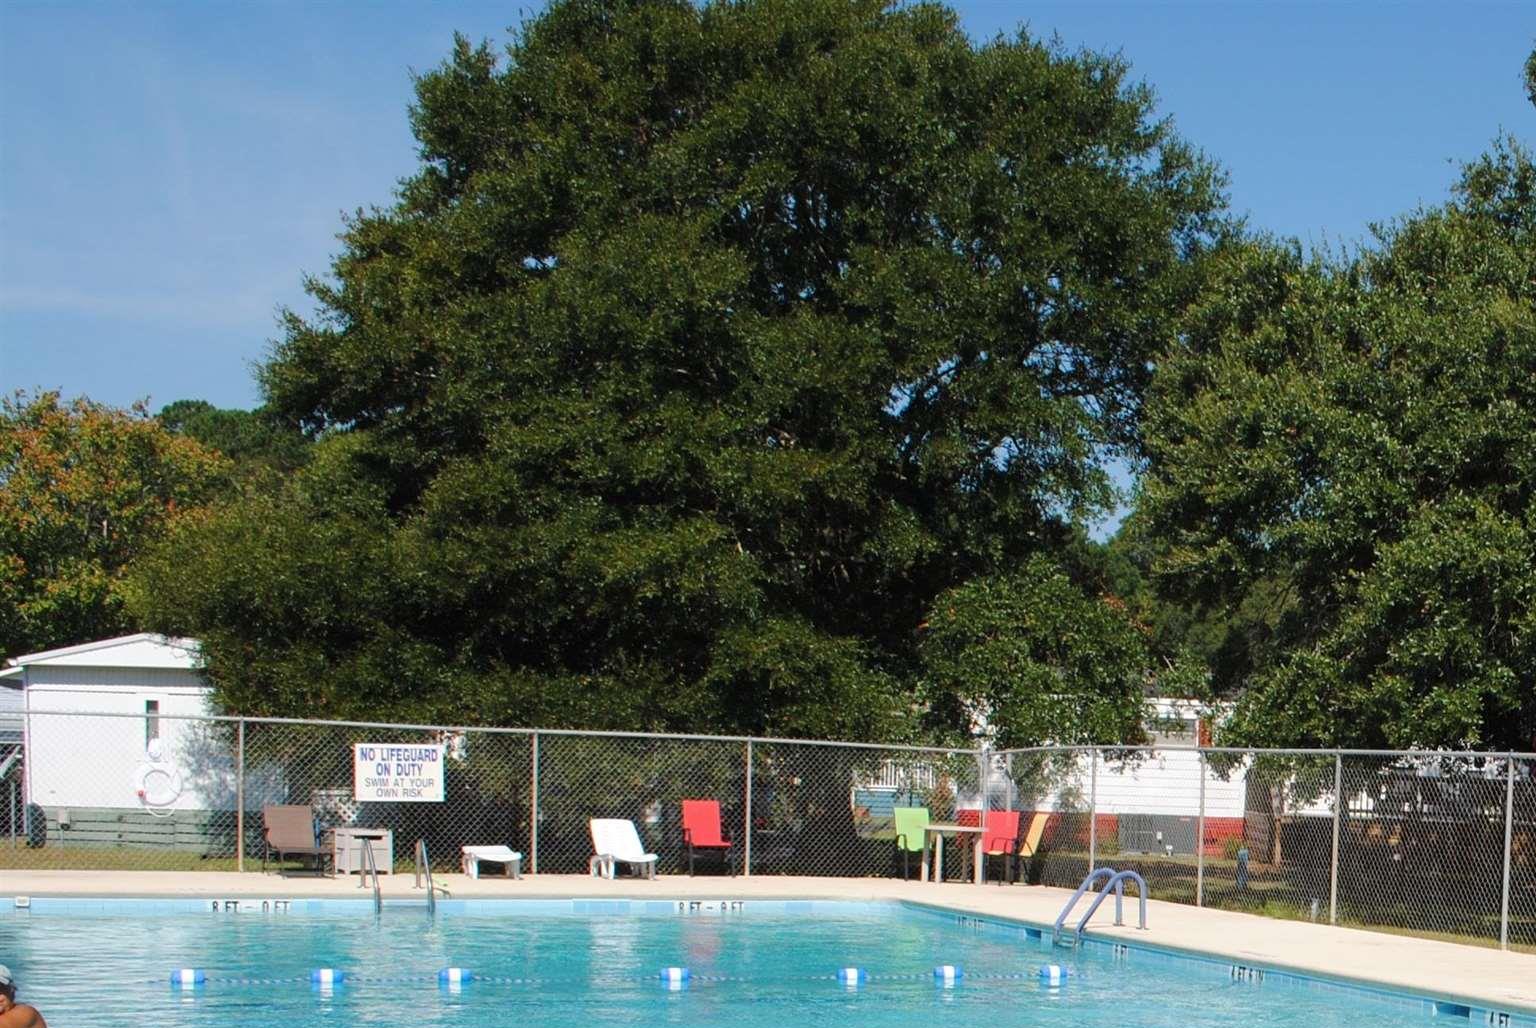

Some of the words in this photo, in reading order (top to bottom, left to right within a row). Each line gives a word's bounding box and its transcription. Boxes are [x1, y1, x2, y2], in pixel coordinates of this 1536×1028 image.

[360, 748, 375, 761] NO
[381, 748, 438, 762] LIFEGUARD
[376, 763, 391, 776] ON
[397, 763, 423, 776] DUTY
[365, 778, 389, 788] SWIM
[394, 778, 405, 788] AT
[410, 778, 434, 788] YOUR
[376, 788, 398, 798] OWN
[403, 788, 424, 798] RISK
